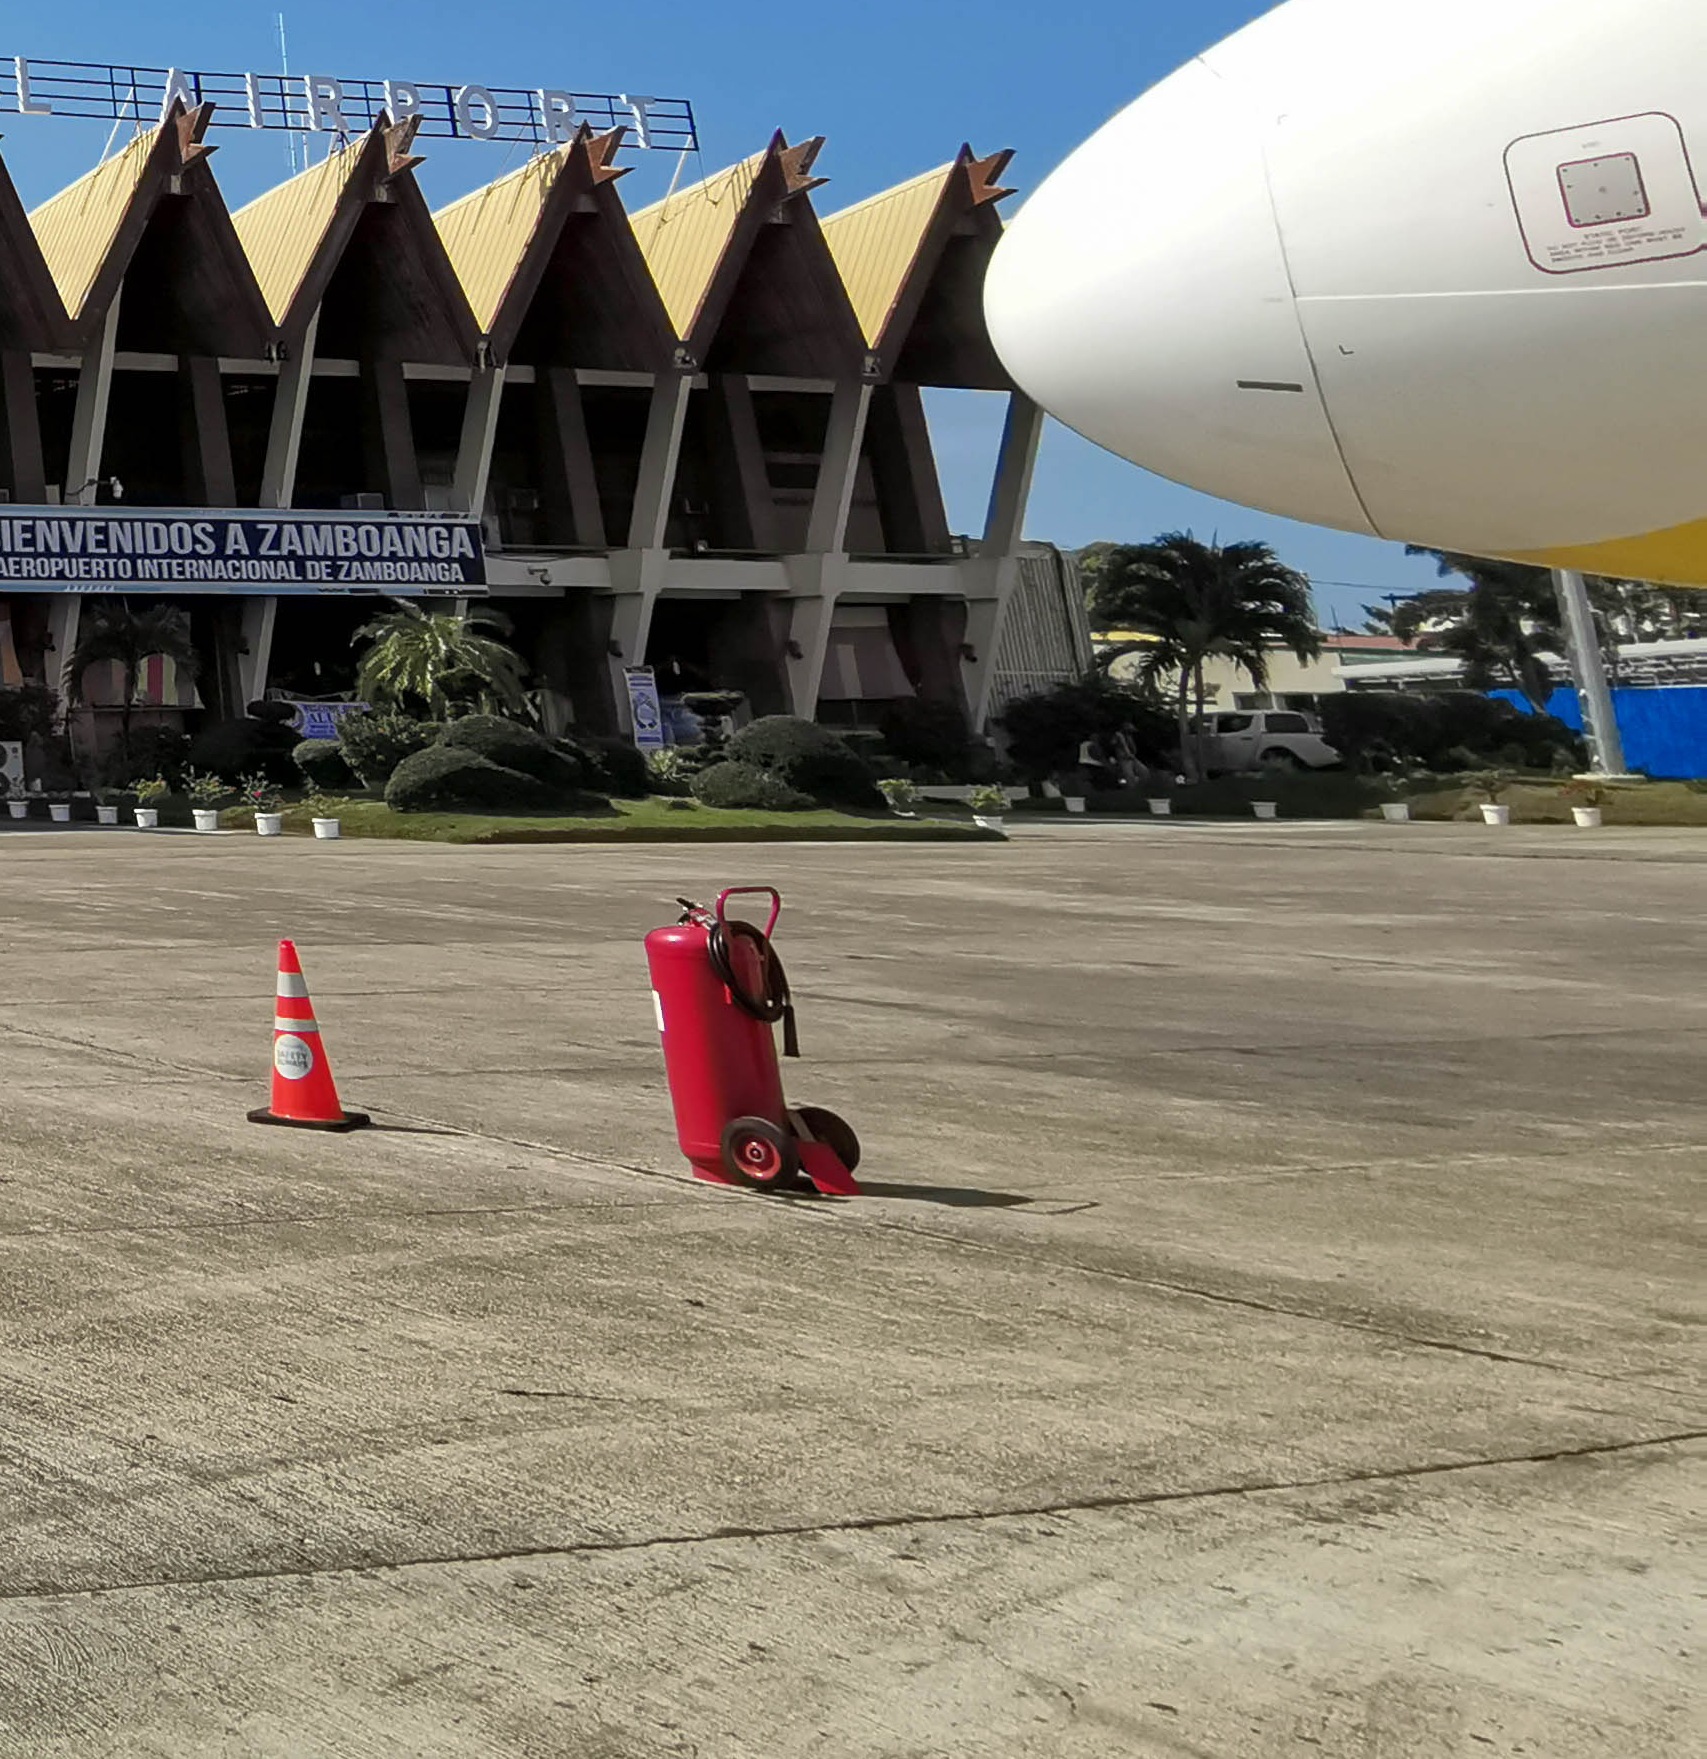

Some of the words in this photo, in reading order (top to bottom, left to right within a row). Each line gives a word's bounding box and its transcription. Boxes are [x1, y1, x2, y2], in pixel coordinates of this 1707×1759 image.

[163, 66, 656, 149] AIRPORT
[224, 522, 250, 556] A
[256, 523, 475, 559] ZAMBOANGA
[137, 558, 303, 581] INTERNACIONAL
[305, 560, 334, 580] DE
[336, 560, 465, 583] ZAMBOANGA
